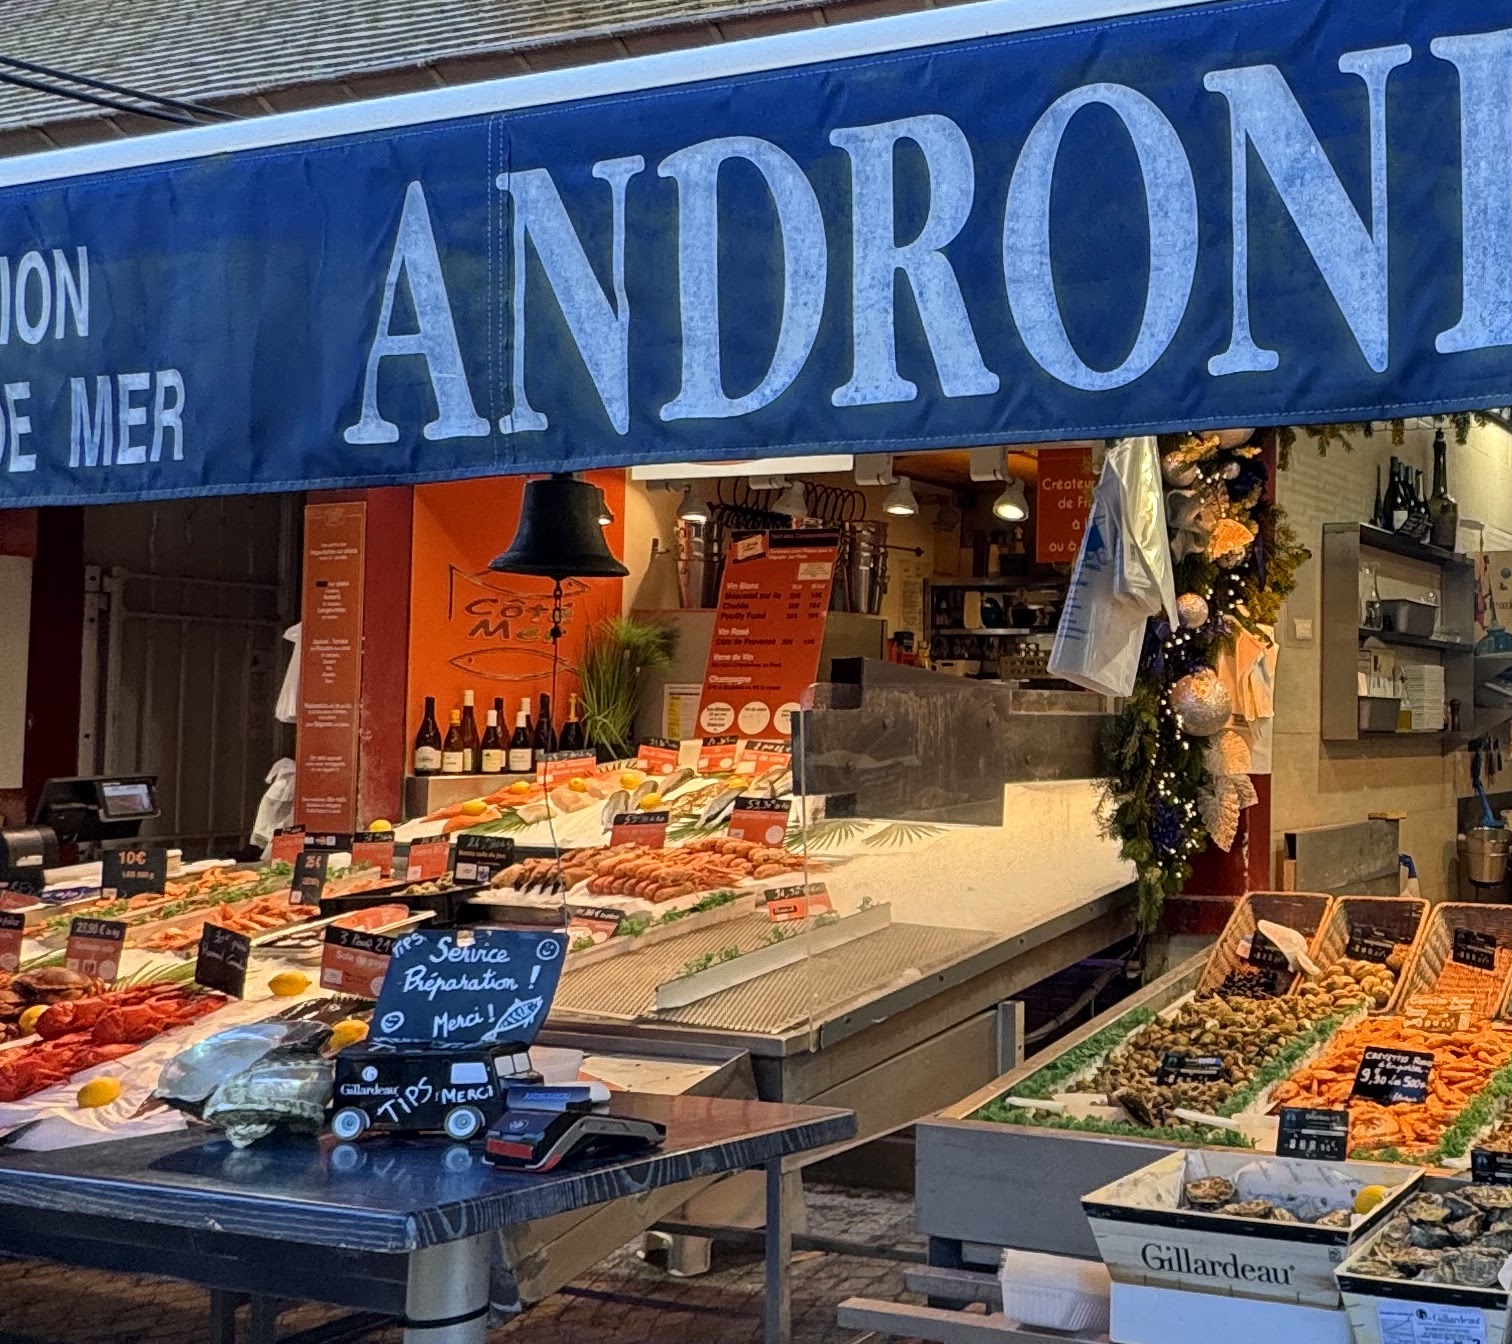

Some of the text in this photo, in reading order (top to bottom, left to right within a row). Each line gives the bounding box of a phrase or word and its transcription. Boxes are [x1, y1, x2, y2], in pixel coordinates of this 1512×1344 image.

[0, 369, 184, 472] E MER
[1058, 497, 1073, 509] de
[1049, 542, 1066, 552] ou
[429, 935, 511, 966] Service
[402, 964, 519, 1001] Préparation
[376, 1076, 433, 1123] TIPS
[1141, 1243, 1295, 1285] Gillardeau
